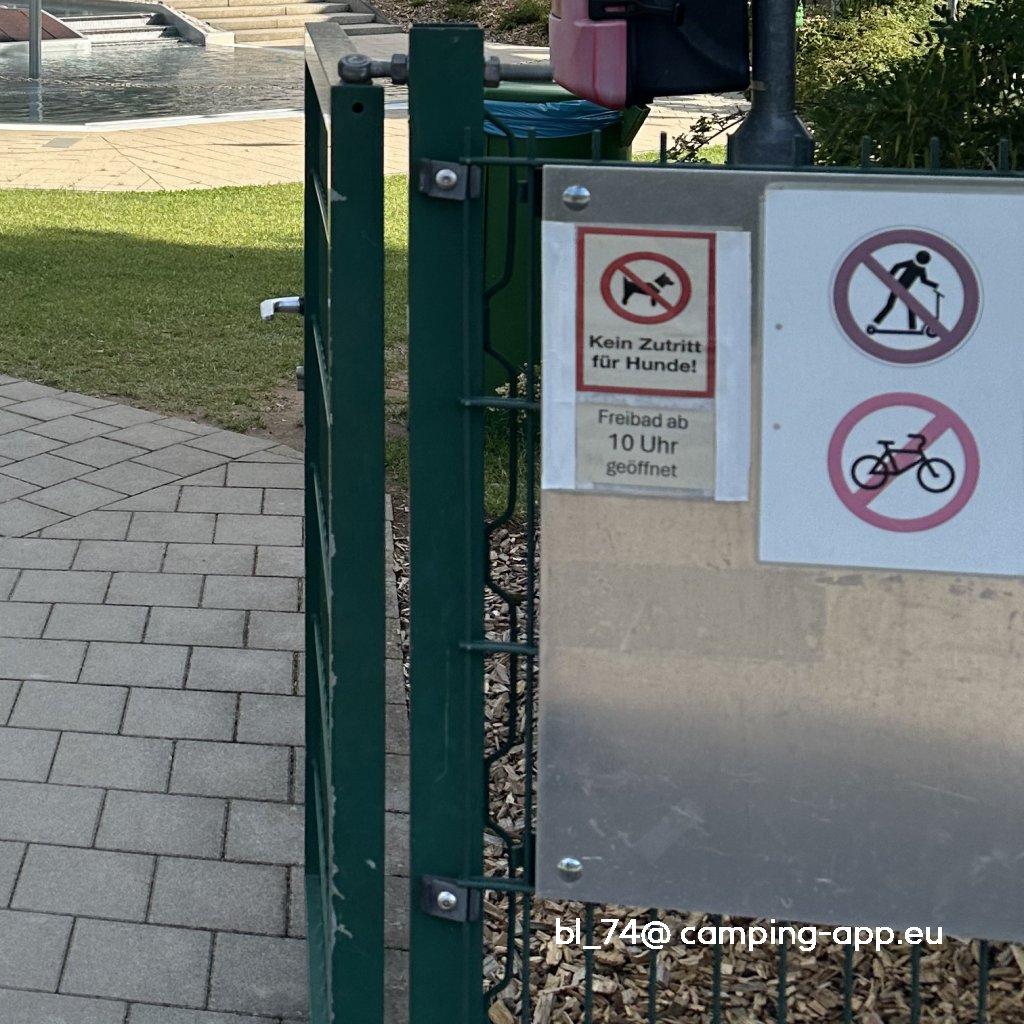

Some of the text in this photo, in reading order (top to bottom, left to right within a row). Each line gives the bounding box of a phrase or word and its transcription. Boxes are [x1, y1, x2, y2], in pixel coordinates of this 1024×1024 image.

[589, 335, 702, 353] Kein Zutritt
[592, 354, 697, 373] für Hunde!
[598, 409, 689, 430] Freibad ab
[608, 433, 679, 455] 10 Uhr
[605, 460, 678, 478] geöffnet
